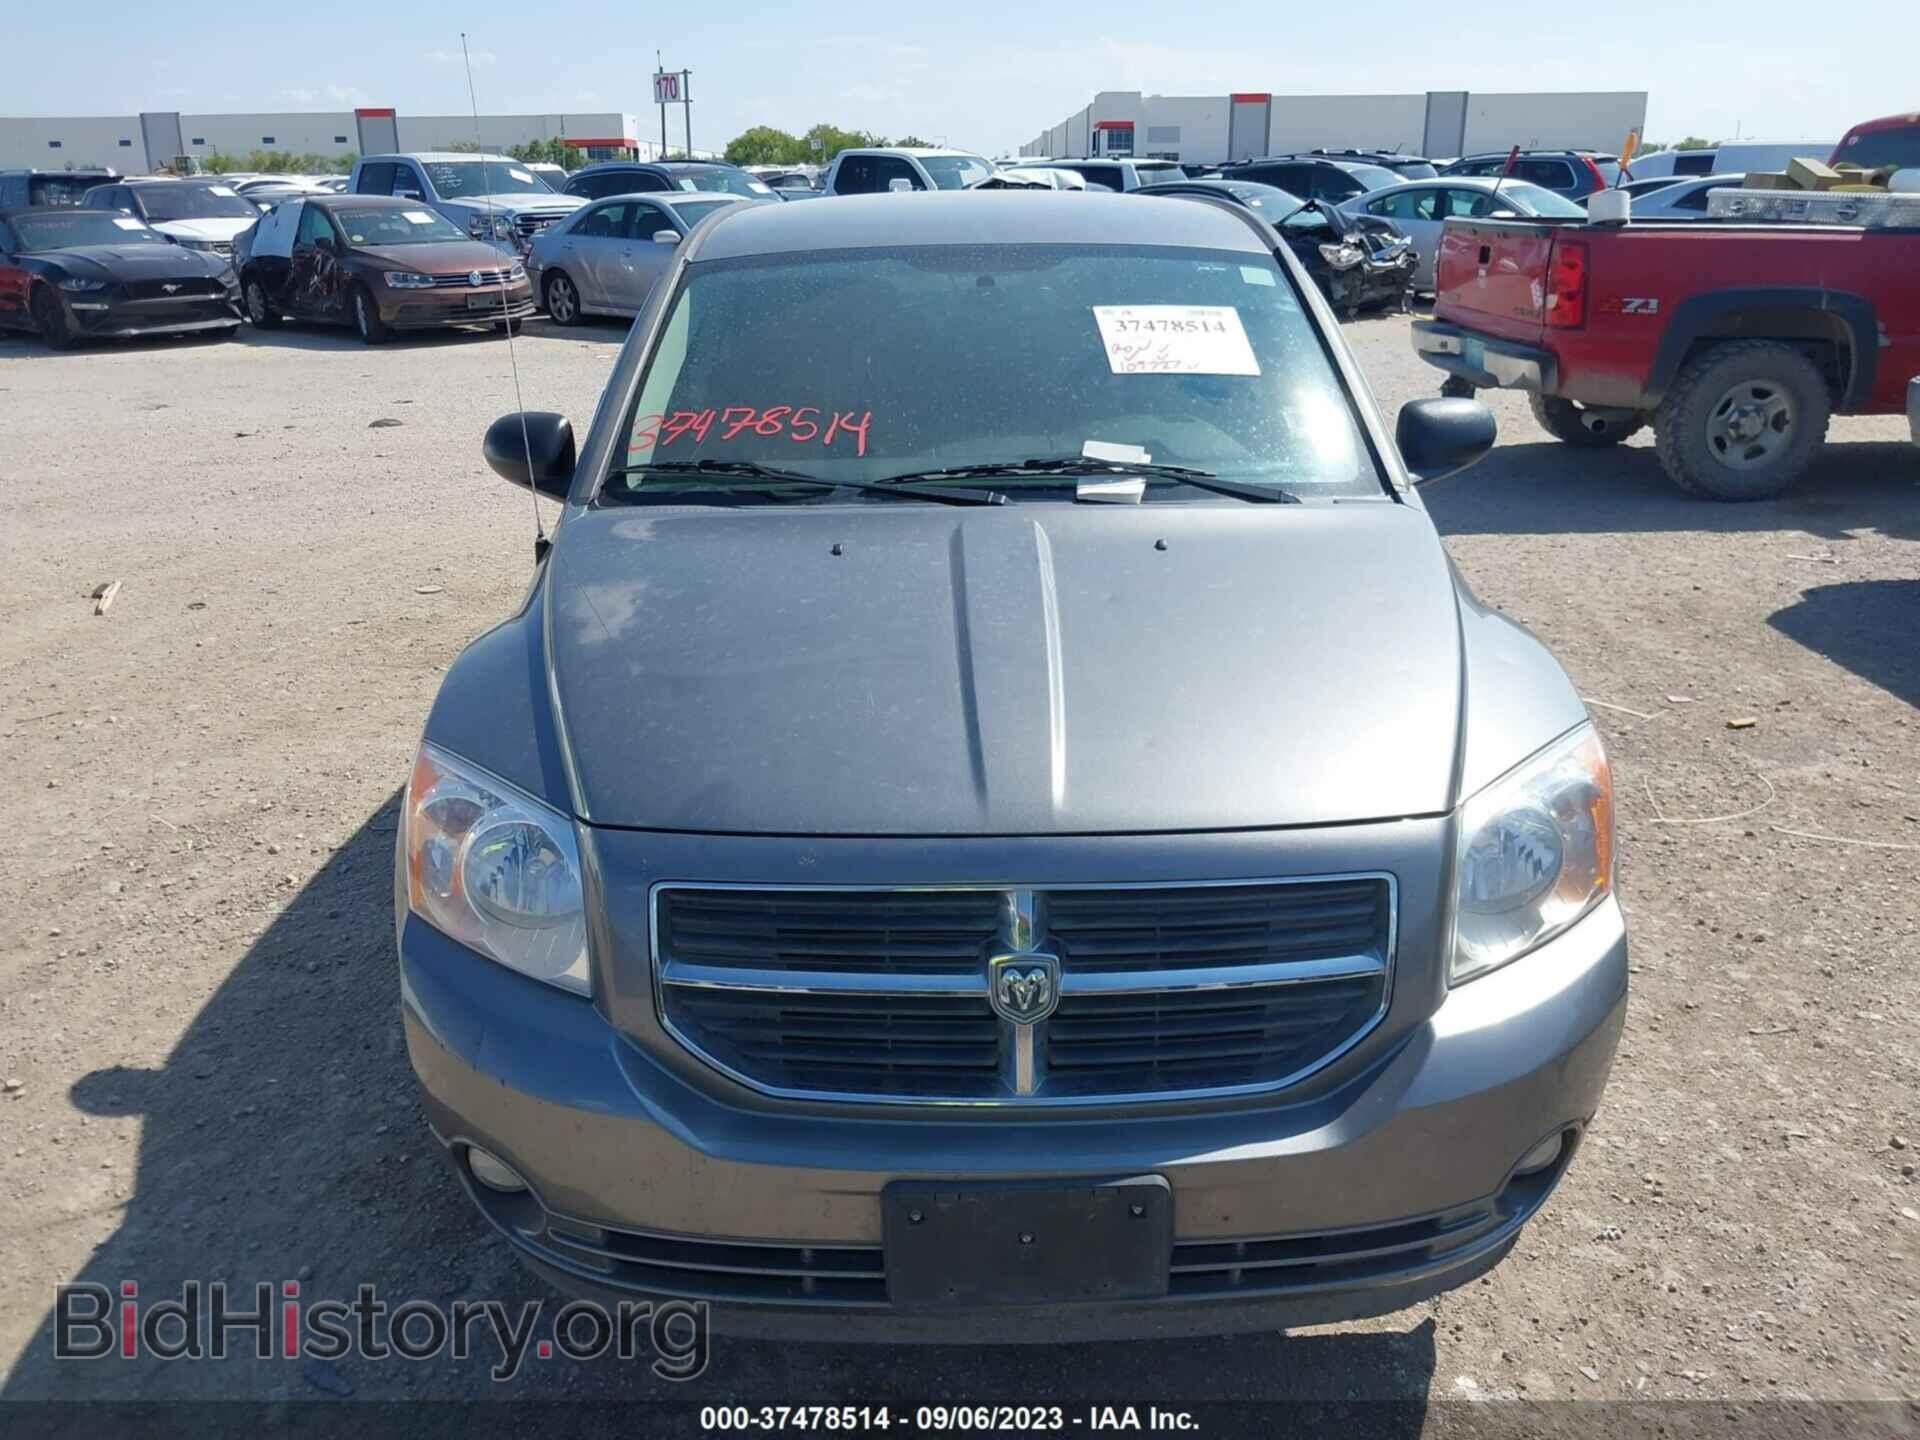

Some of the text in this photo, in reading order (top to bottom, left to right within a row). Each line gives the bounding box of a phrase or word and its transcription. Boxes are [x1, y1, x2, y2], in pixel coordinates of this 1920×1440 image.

[656, 76, 677, 99] 170
[1115, 320, 1226, 333] 37478514
[628, 406, 871, 456] 37478514
